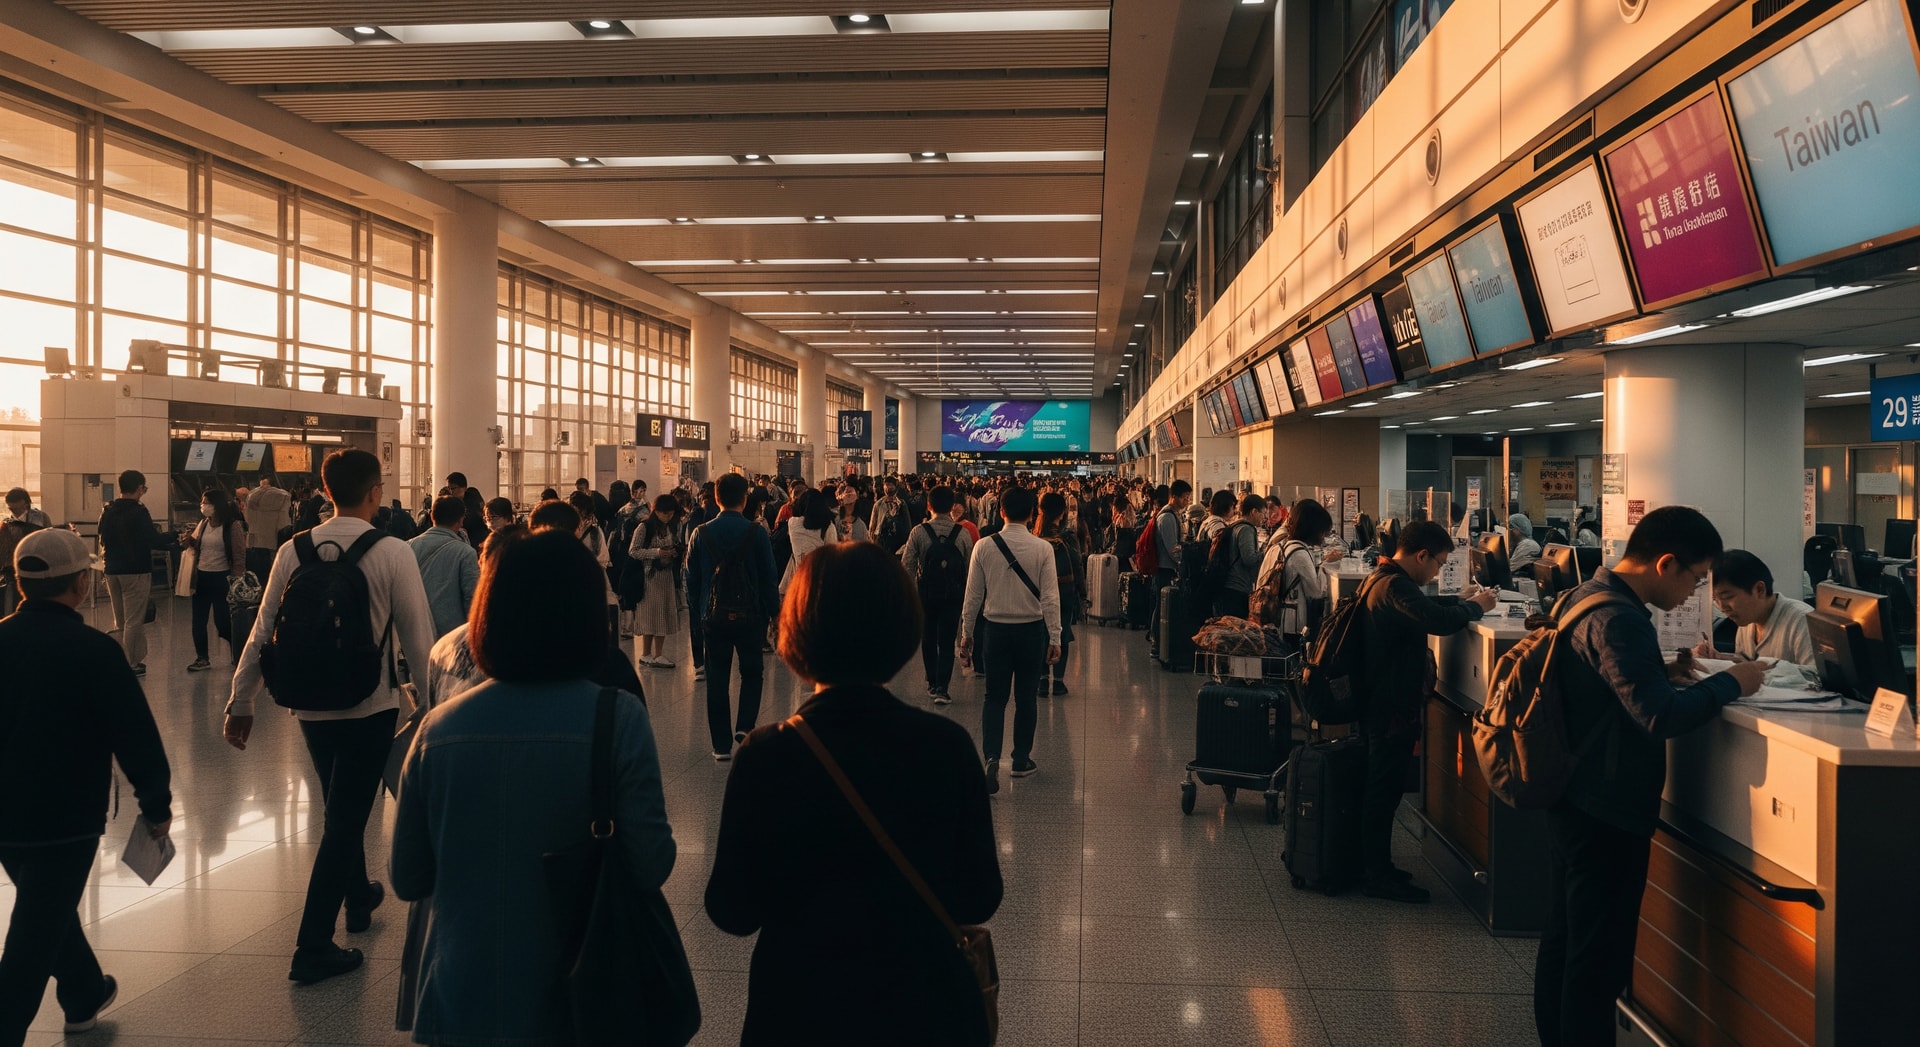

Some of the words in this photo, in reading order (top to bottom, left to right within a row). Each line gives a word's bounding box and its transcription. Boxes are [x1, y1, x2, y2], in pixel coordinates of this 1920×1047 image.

[1774, 100, 1880, 172] Taiwan
[1470, 274, 1505, 304] Taiwan
[1882, 396, 1908, 428] 29
